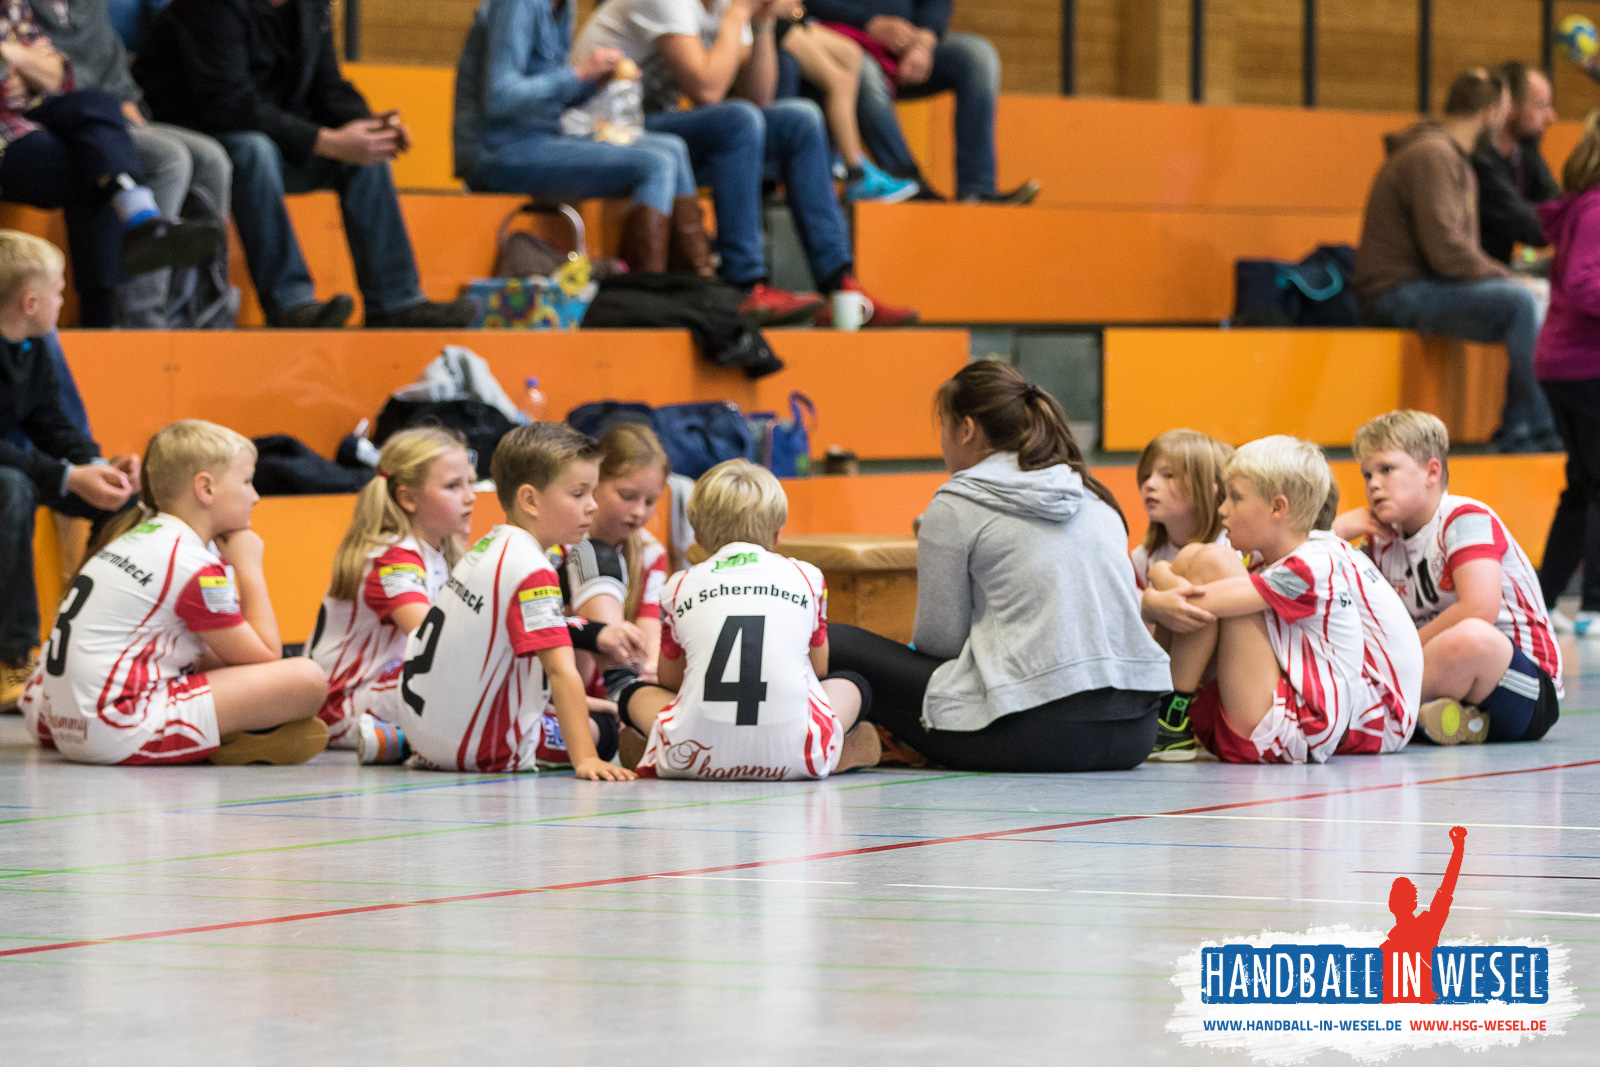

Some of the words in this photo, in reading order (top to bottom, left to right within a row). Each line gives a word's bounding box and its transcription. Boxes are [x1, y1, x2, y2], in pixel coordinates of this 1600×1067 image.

[46, 574, 94, 676] 3
[676, 597, 693, 618] SV
[699, 584, 809, 609] Schermbeck
[401, 605, 445, 717] 2
[703, 615, 768, 726] 4
[665, 739, 791, 780] Thommy
